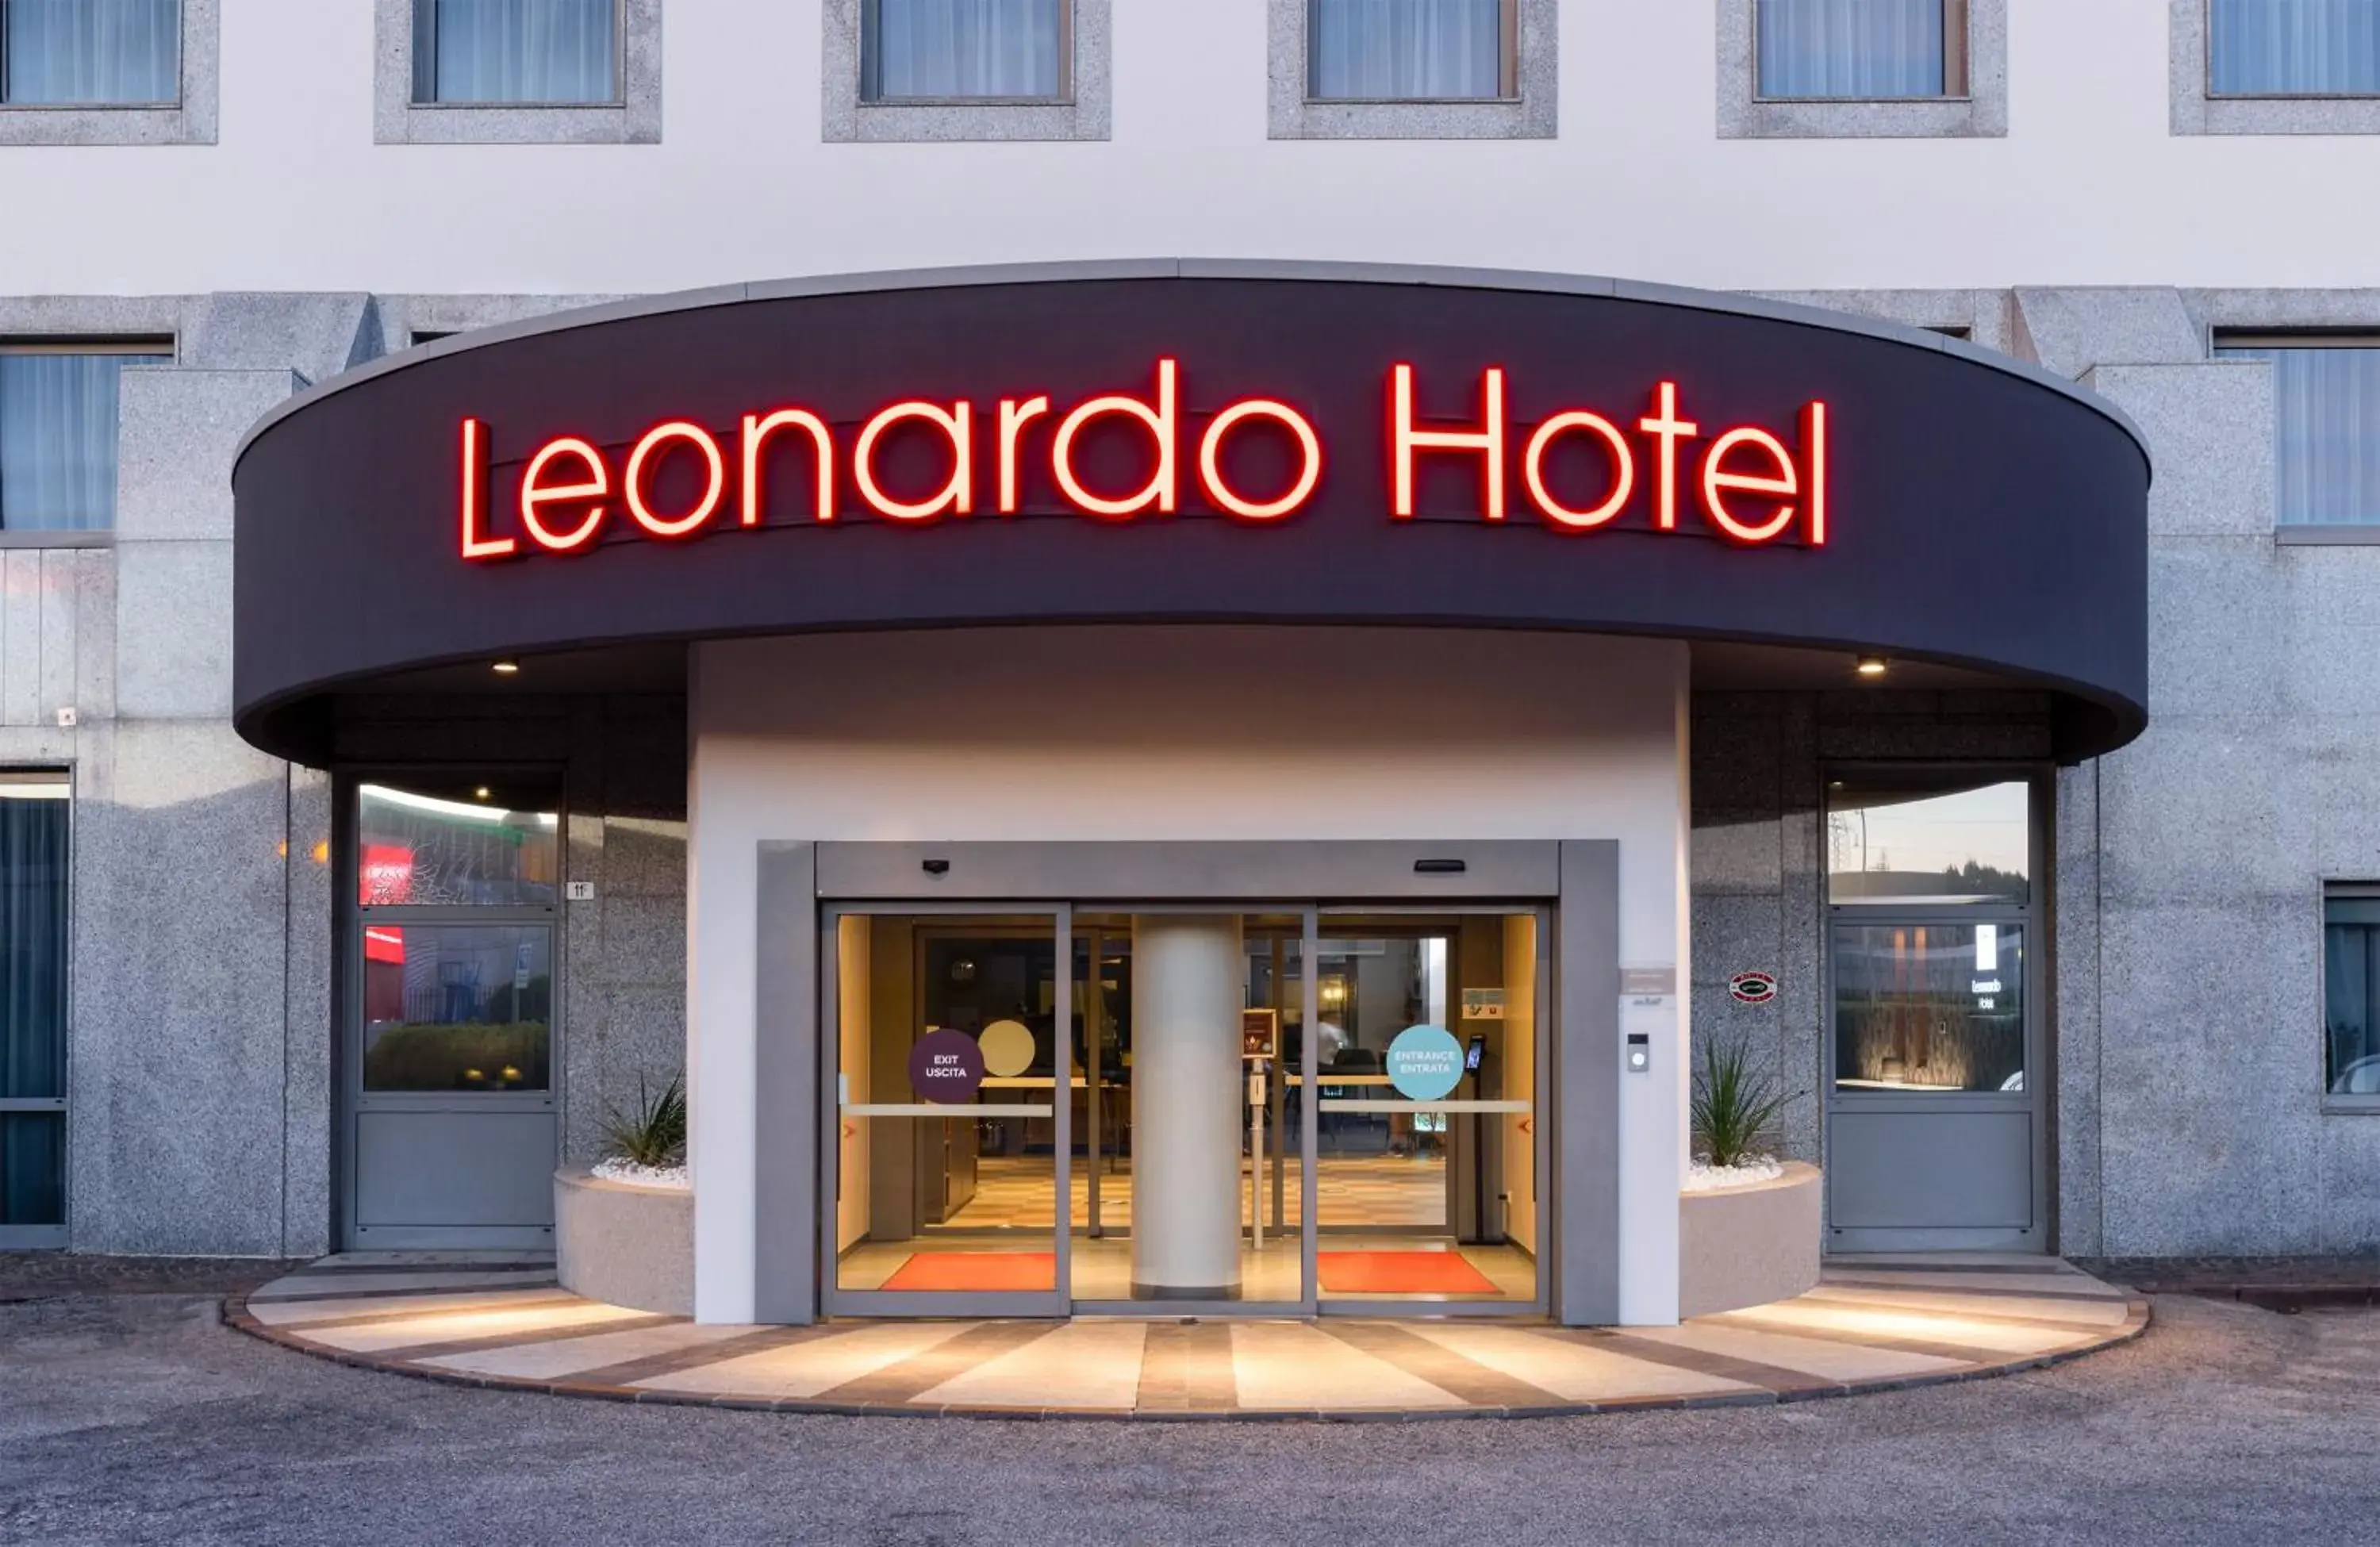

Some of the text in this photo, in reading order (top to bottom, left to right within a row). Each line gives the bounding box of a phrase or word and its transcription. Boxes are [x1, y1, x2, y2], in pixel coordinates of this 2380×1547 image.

[460, 357, 1826, 559] Leonardo Hotel
[934, 1055, 958, 1064] EXIT
[1395, 1051, 1456, 1061] ENTRANCE
[926, 1068, 966, 1077] USCITA
[1400, 1063, 1450, 1074] ENTRATA
